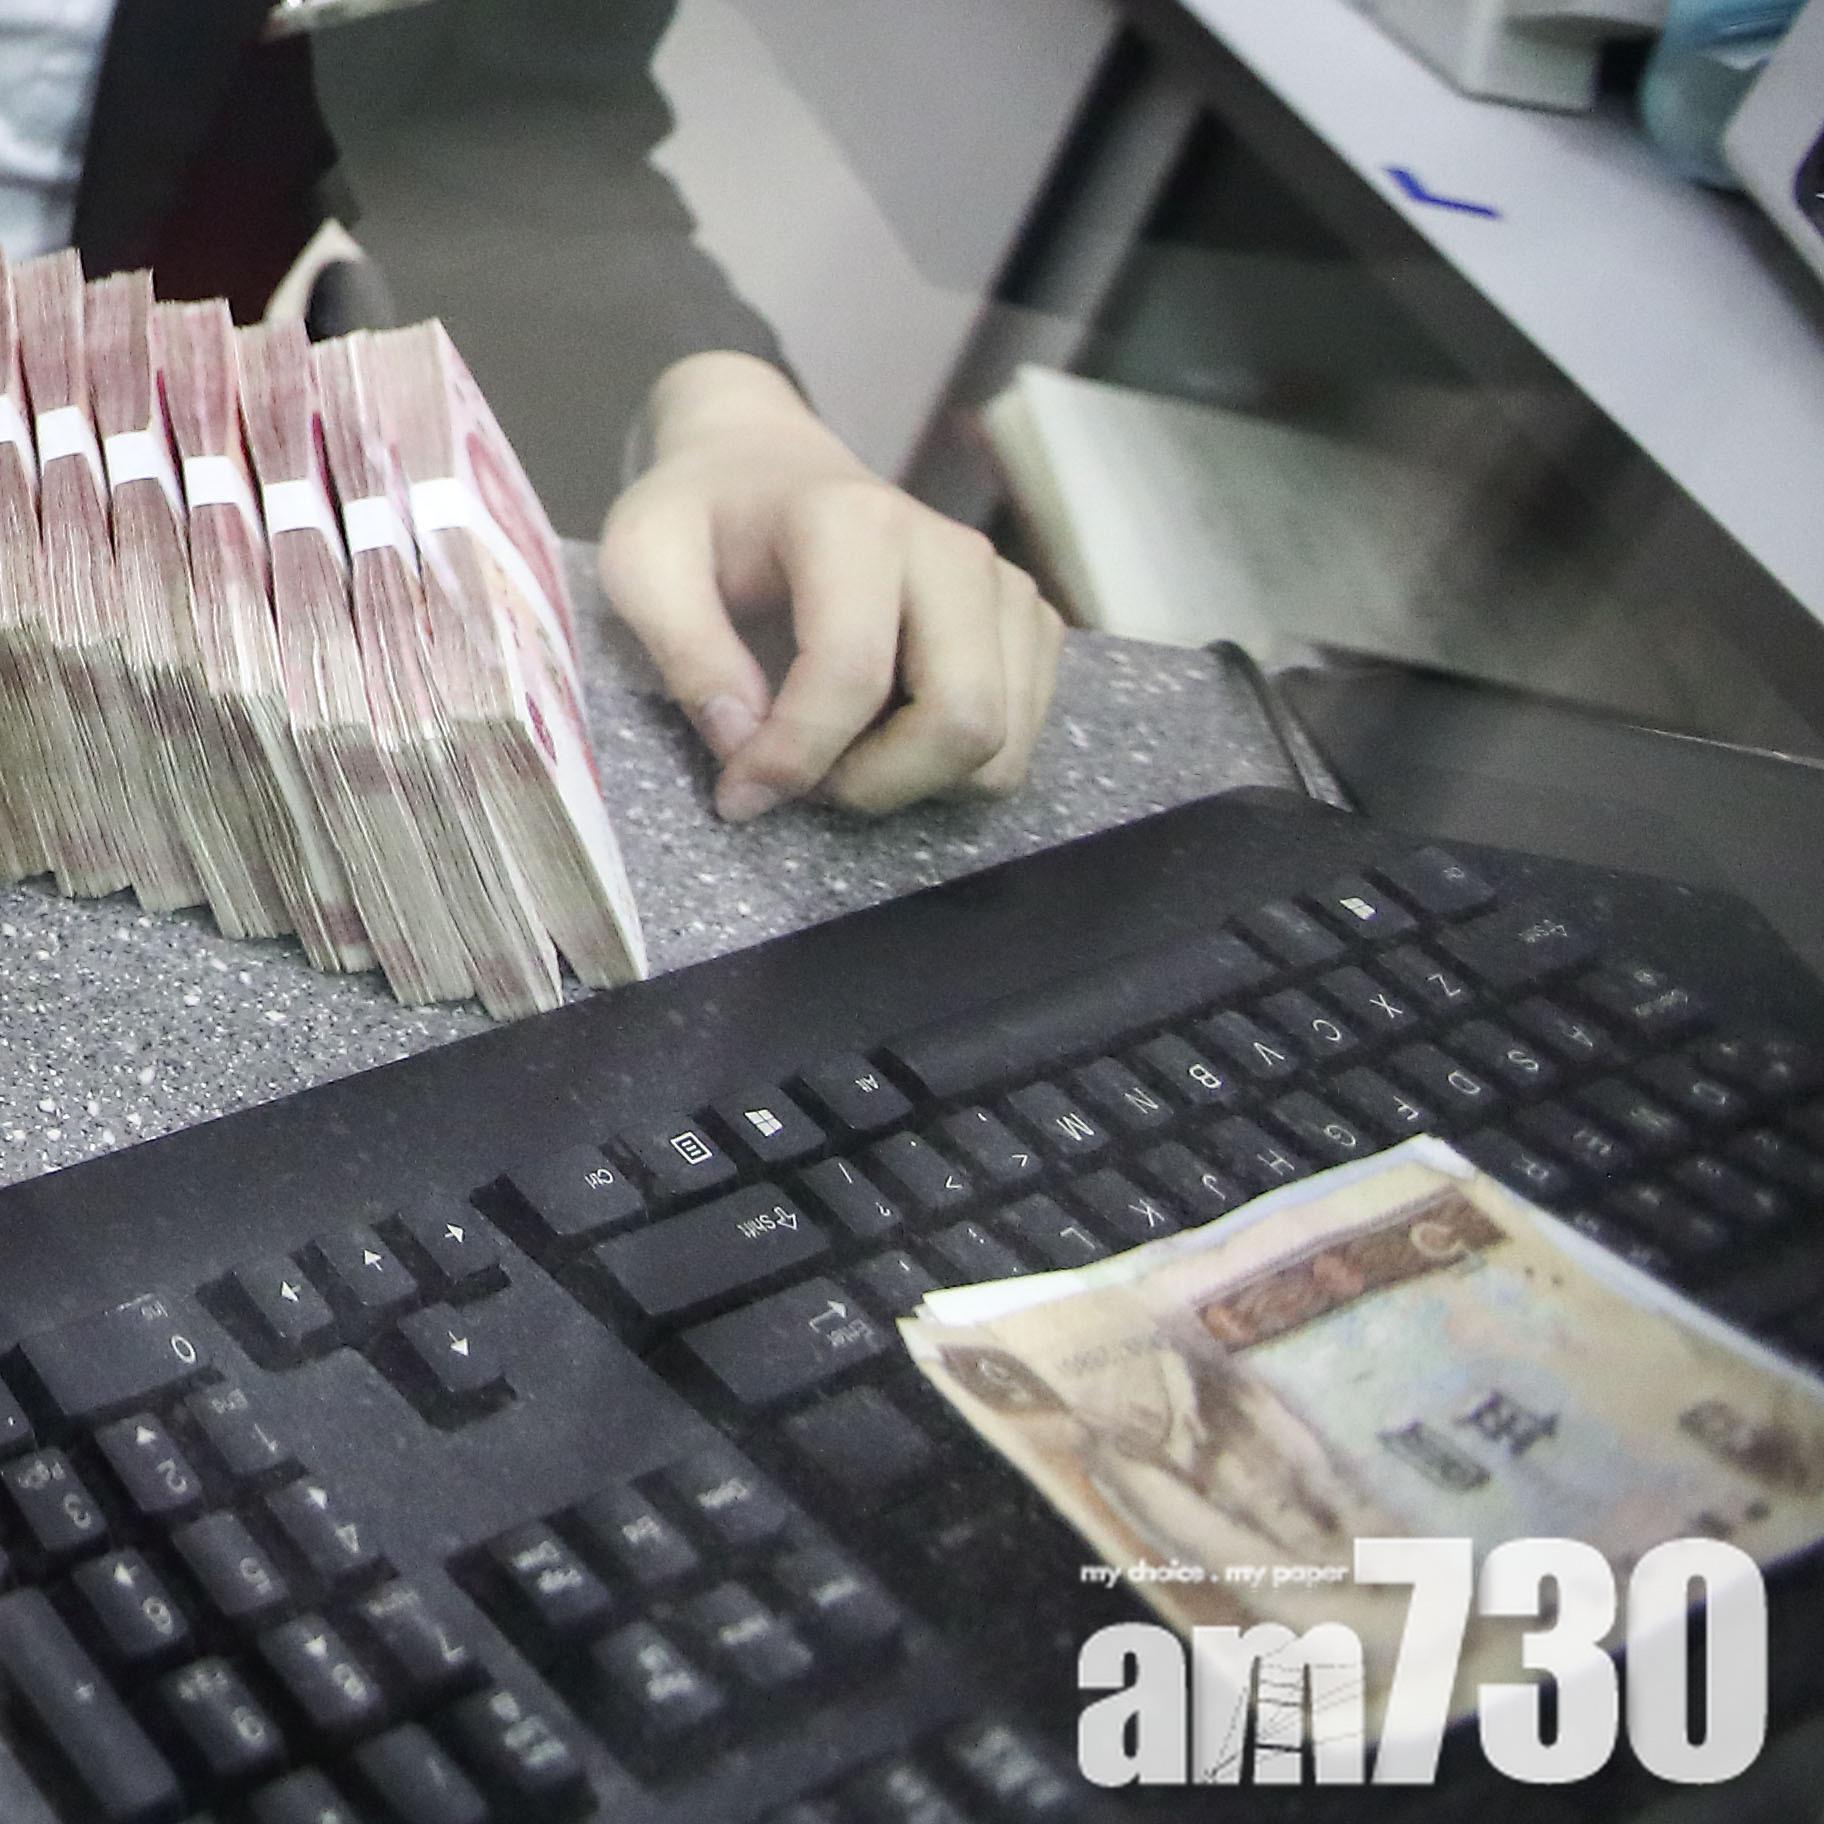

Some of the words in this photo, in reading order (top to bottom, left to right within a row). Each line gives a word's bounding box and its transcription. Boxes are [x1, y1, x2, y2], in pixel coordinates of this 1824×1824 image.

[1427, 972, 1462, 998] Z
[1369, 993, 1404, 1019] X
[1312, 1018, 1343, 1043] C
[1253, 1041, 1285, 1067] V
[1507, 1049, 1540, 1073] S
[1189, 1063, 1222, 1089] B
[1447, 1070, 1482, 1096] D
[1124, 1087, 1160, 1115] N
[1393, 1096, 1420, 1121] F
[1055, 1112, 1095, 1142] M
[1322, 1123, 1357, 1149] G
[1255, 1146, 1298, 1178] H
[584, 1168, 614, 1190] Ctrl
[1201, 1172, 1226, 1200] J
[737, 1214, 776, 1238] Shift
[1129, 1198, 1166, 1228] K
[1059, 1225, 1096, 1250] L
[171, 1334, 196, 1364] 0
[157, 1458, 188, 1495] 2
[63, 1493, 92, 1530] 3
[238, 1557, 273, 1595] 5
[142, 1597, 173, 1634] 6
